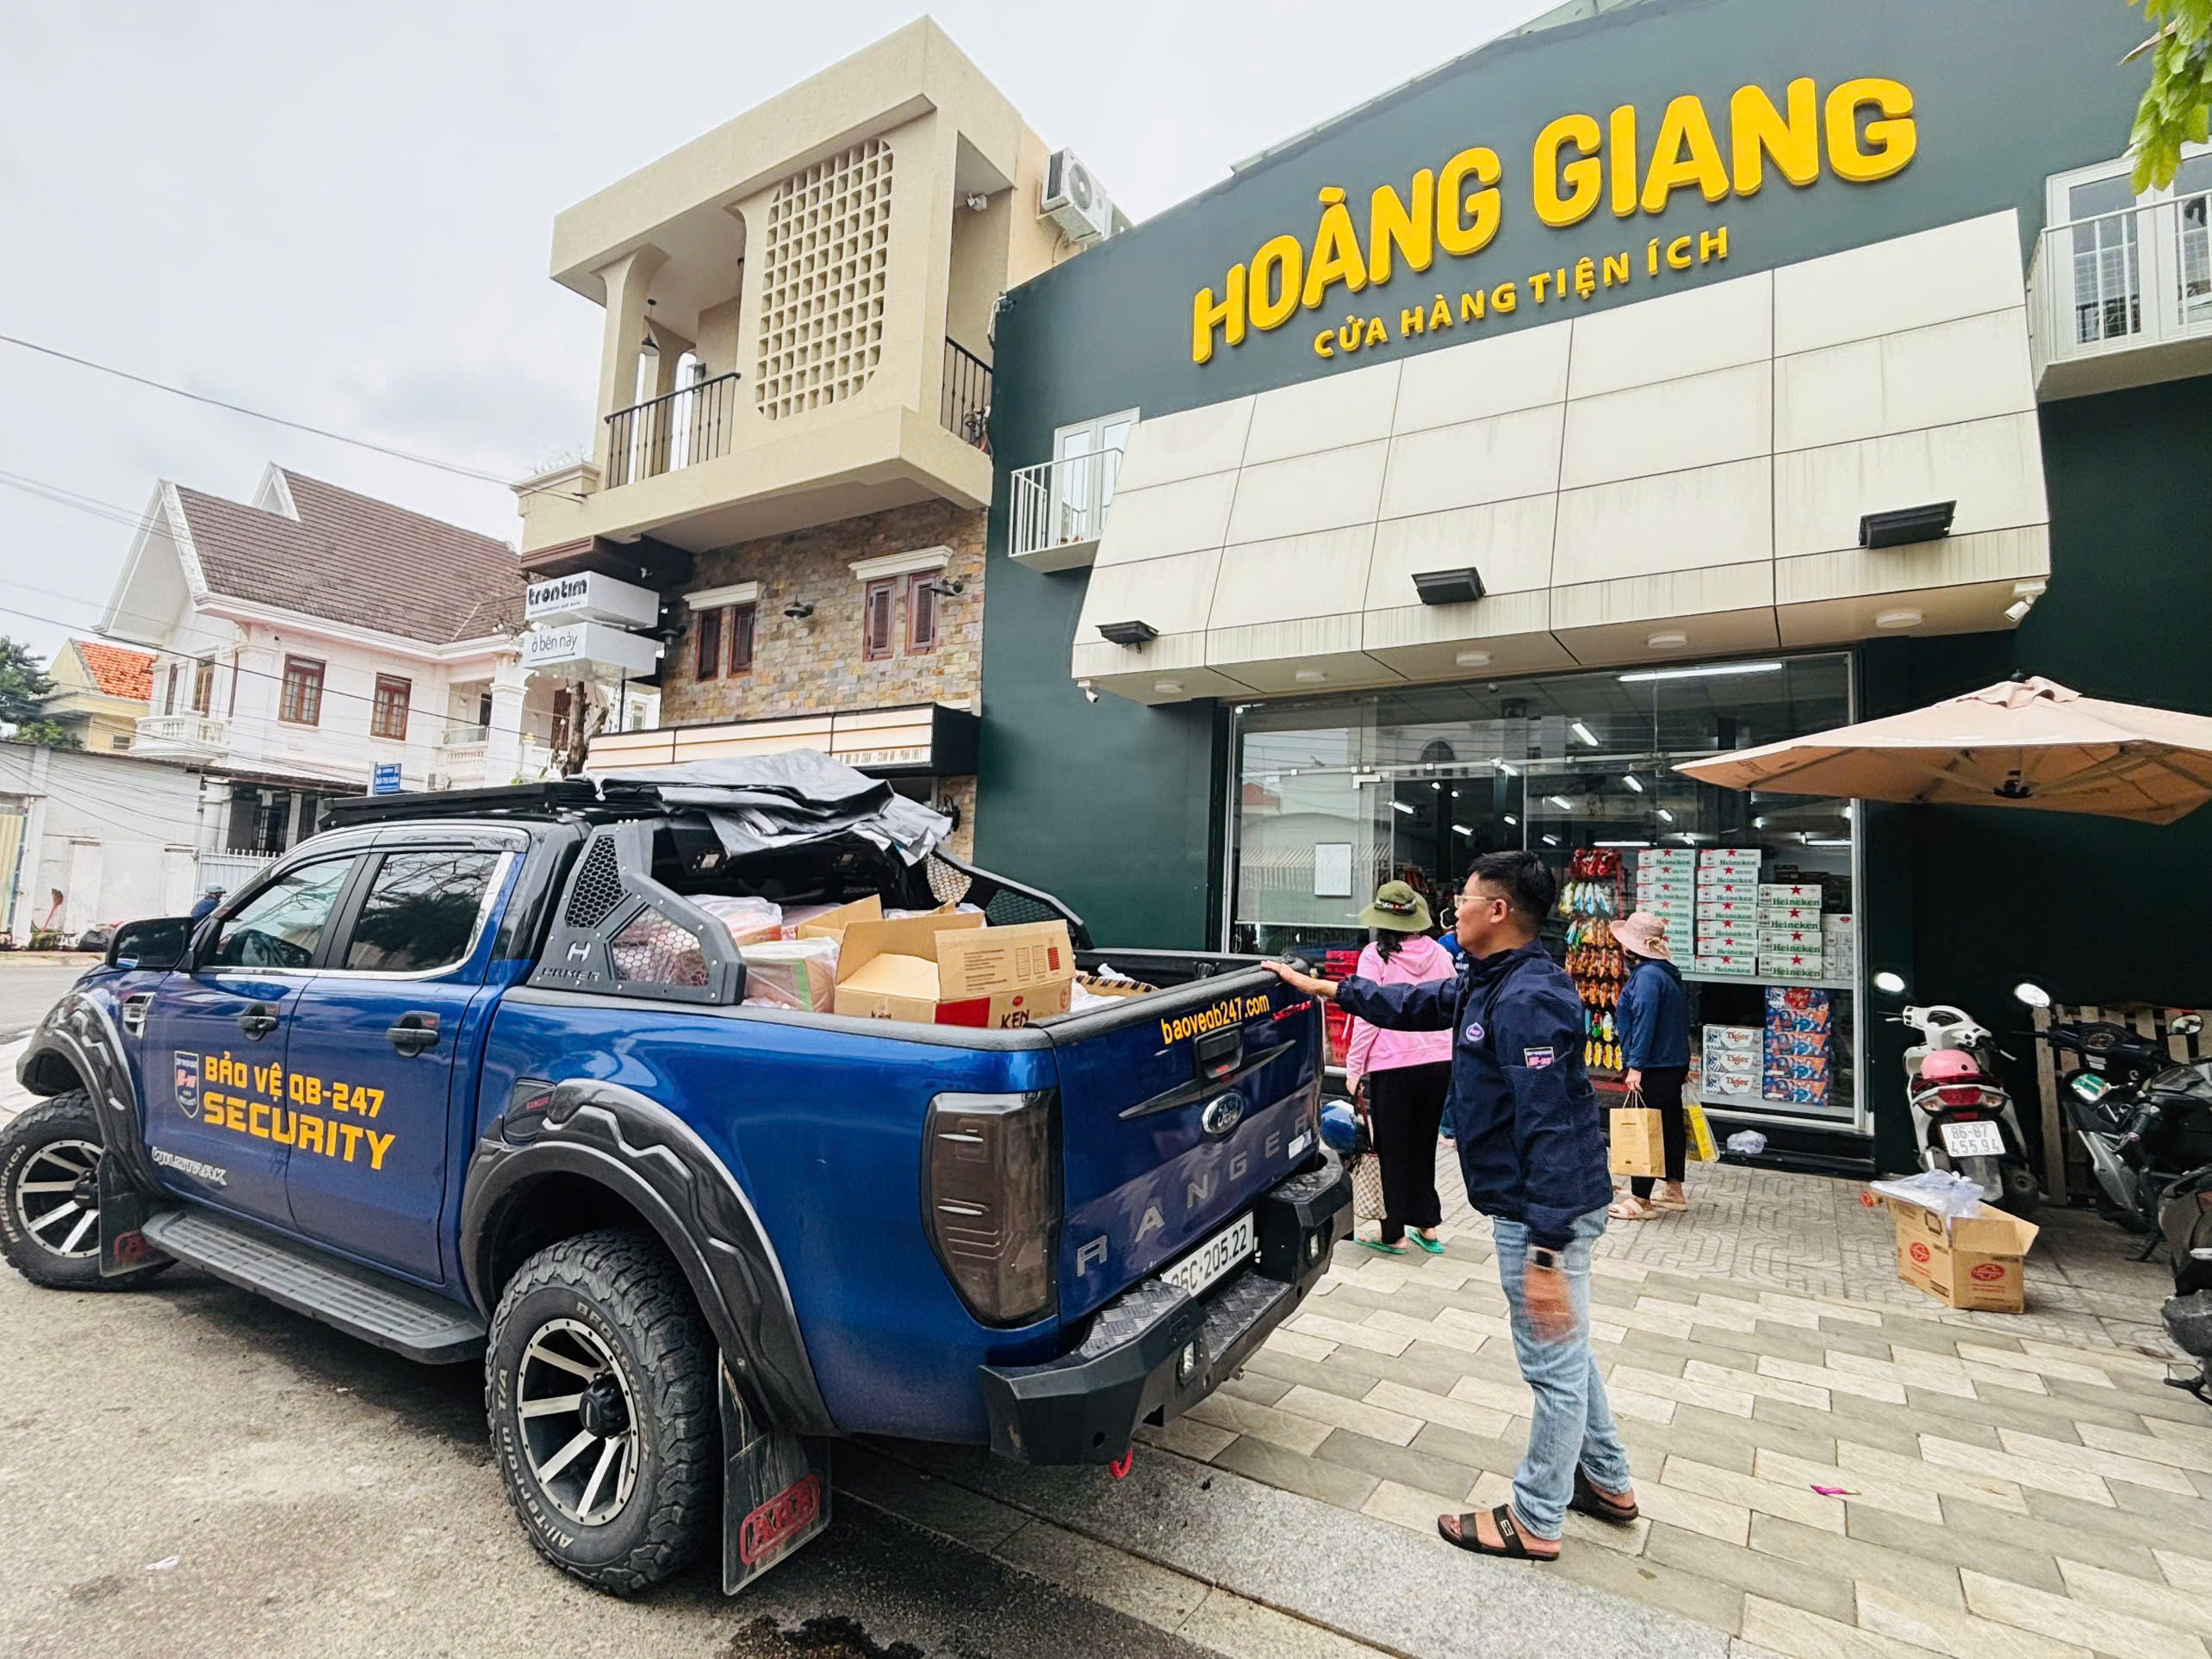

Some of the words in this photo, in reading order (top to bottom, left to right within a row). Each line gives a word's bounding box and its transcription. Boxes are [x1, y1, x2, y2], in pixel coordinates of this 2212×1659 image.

[1192, 146, 1501, 364] HOÀNG
[1533, 77, 1917, 227] GIANG
[1314, 316, 1389, 358] CỬA
[1401, 282, 1517, 339] HÀNG
[1529, 252, 1631, 305] TIỆN
[1646, 227, 1730, 276] ÍCH
[539, 634, 558, 651] bên
[1773, 898, 1820, 906] Heineken
[1771, 920, 1818, 929] Heineken
[1774, 943, 1821, 953] Heineken
[1774, 967, 1821, 977] Heineken
[1725, 1030, 1750, 1042] Tiger
[1725, 1053, 1750, 1066] Tiger
[204, 1050, 248, 1090] BẢO
[253, 1061, 283, 1103] VỆ
[289, 1073, 385, 1118] QB-247
[1725, 1076, 1750, 1088] Tiger
[202, 1090, 396, 1171] SECURITY
